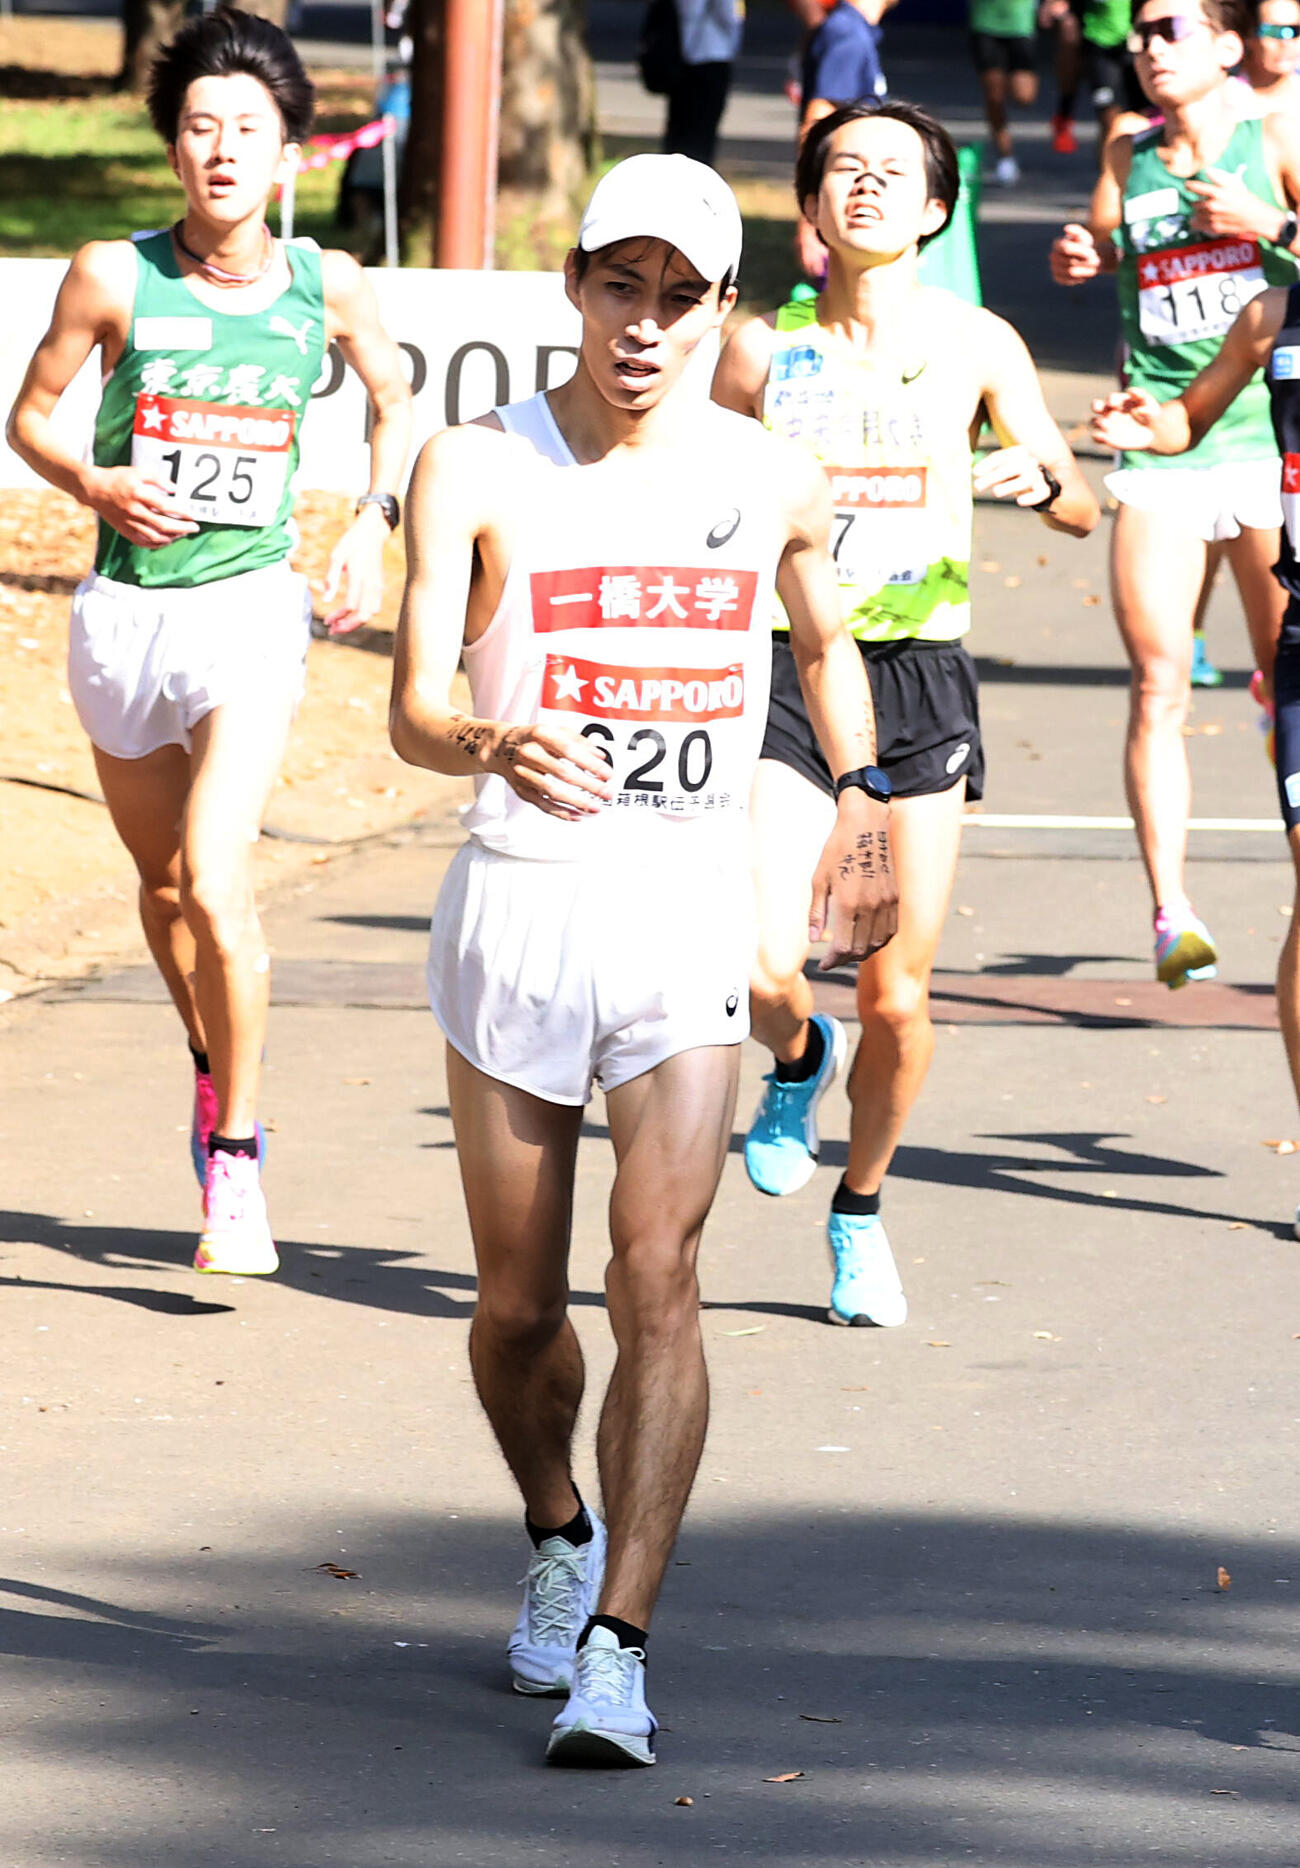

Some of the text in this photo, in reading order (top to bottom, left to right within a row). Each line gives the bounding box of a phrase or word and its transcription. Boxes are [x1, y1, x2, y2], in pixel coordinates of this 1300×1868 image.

[1159, 242, 1256, 280] SAPPORO
[1161, 277, 1242, 328] 118
[169, 410, 291, 448] SAPPORO
[161, 449, 257, 505] 125
[549, 574, 740, 622] 一橋大学
[592, 674, 744, 714] SAPPORO
